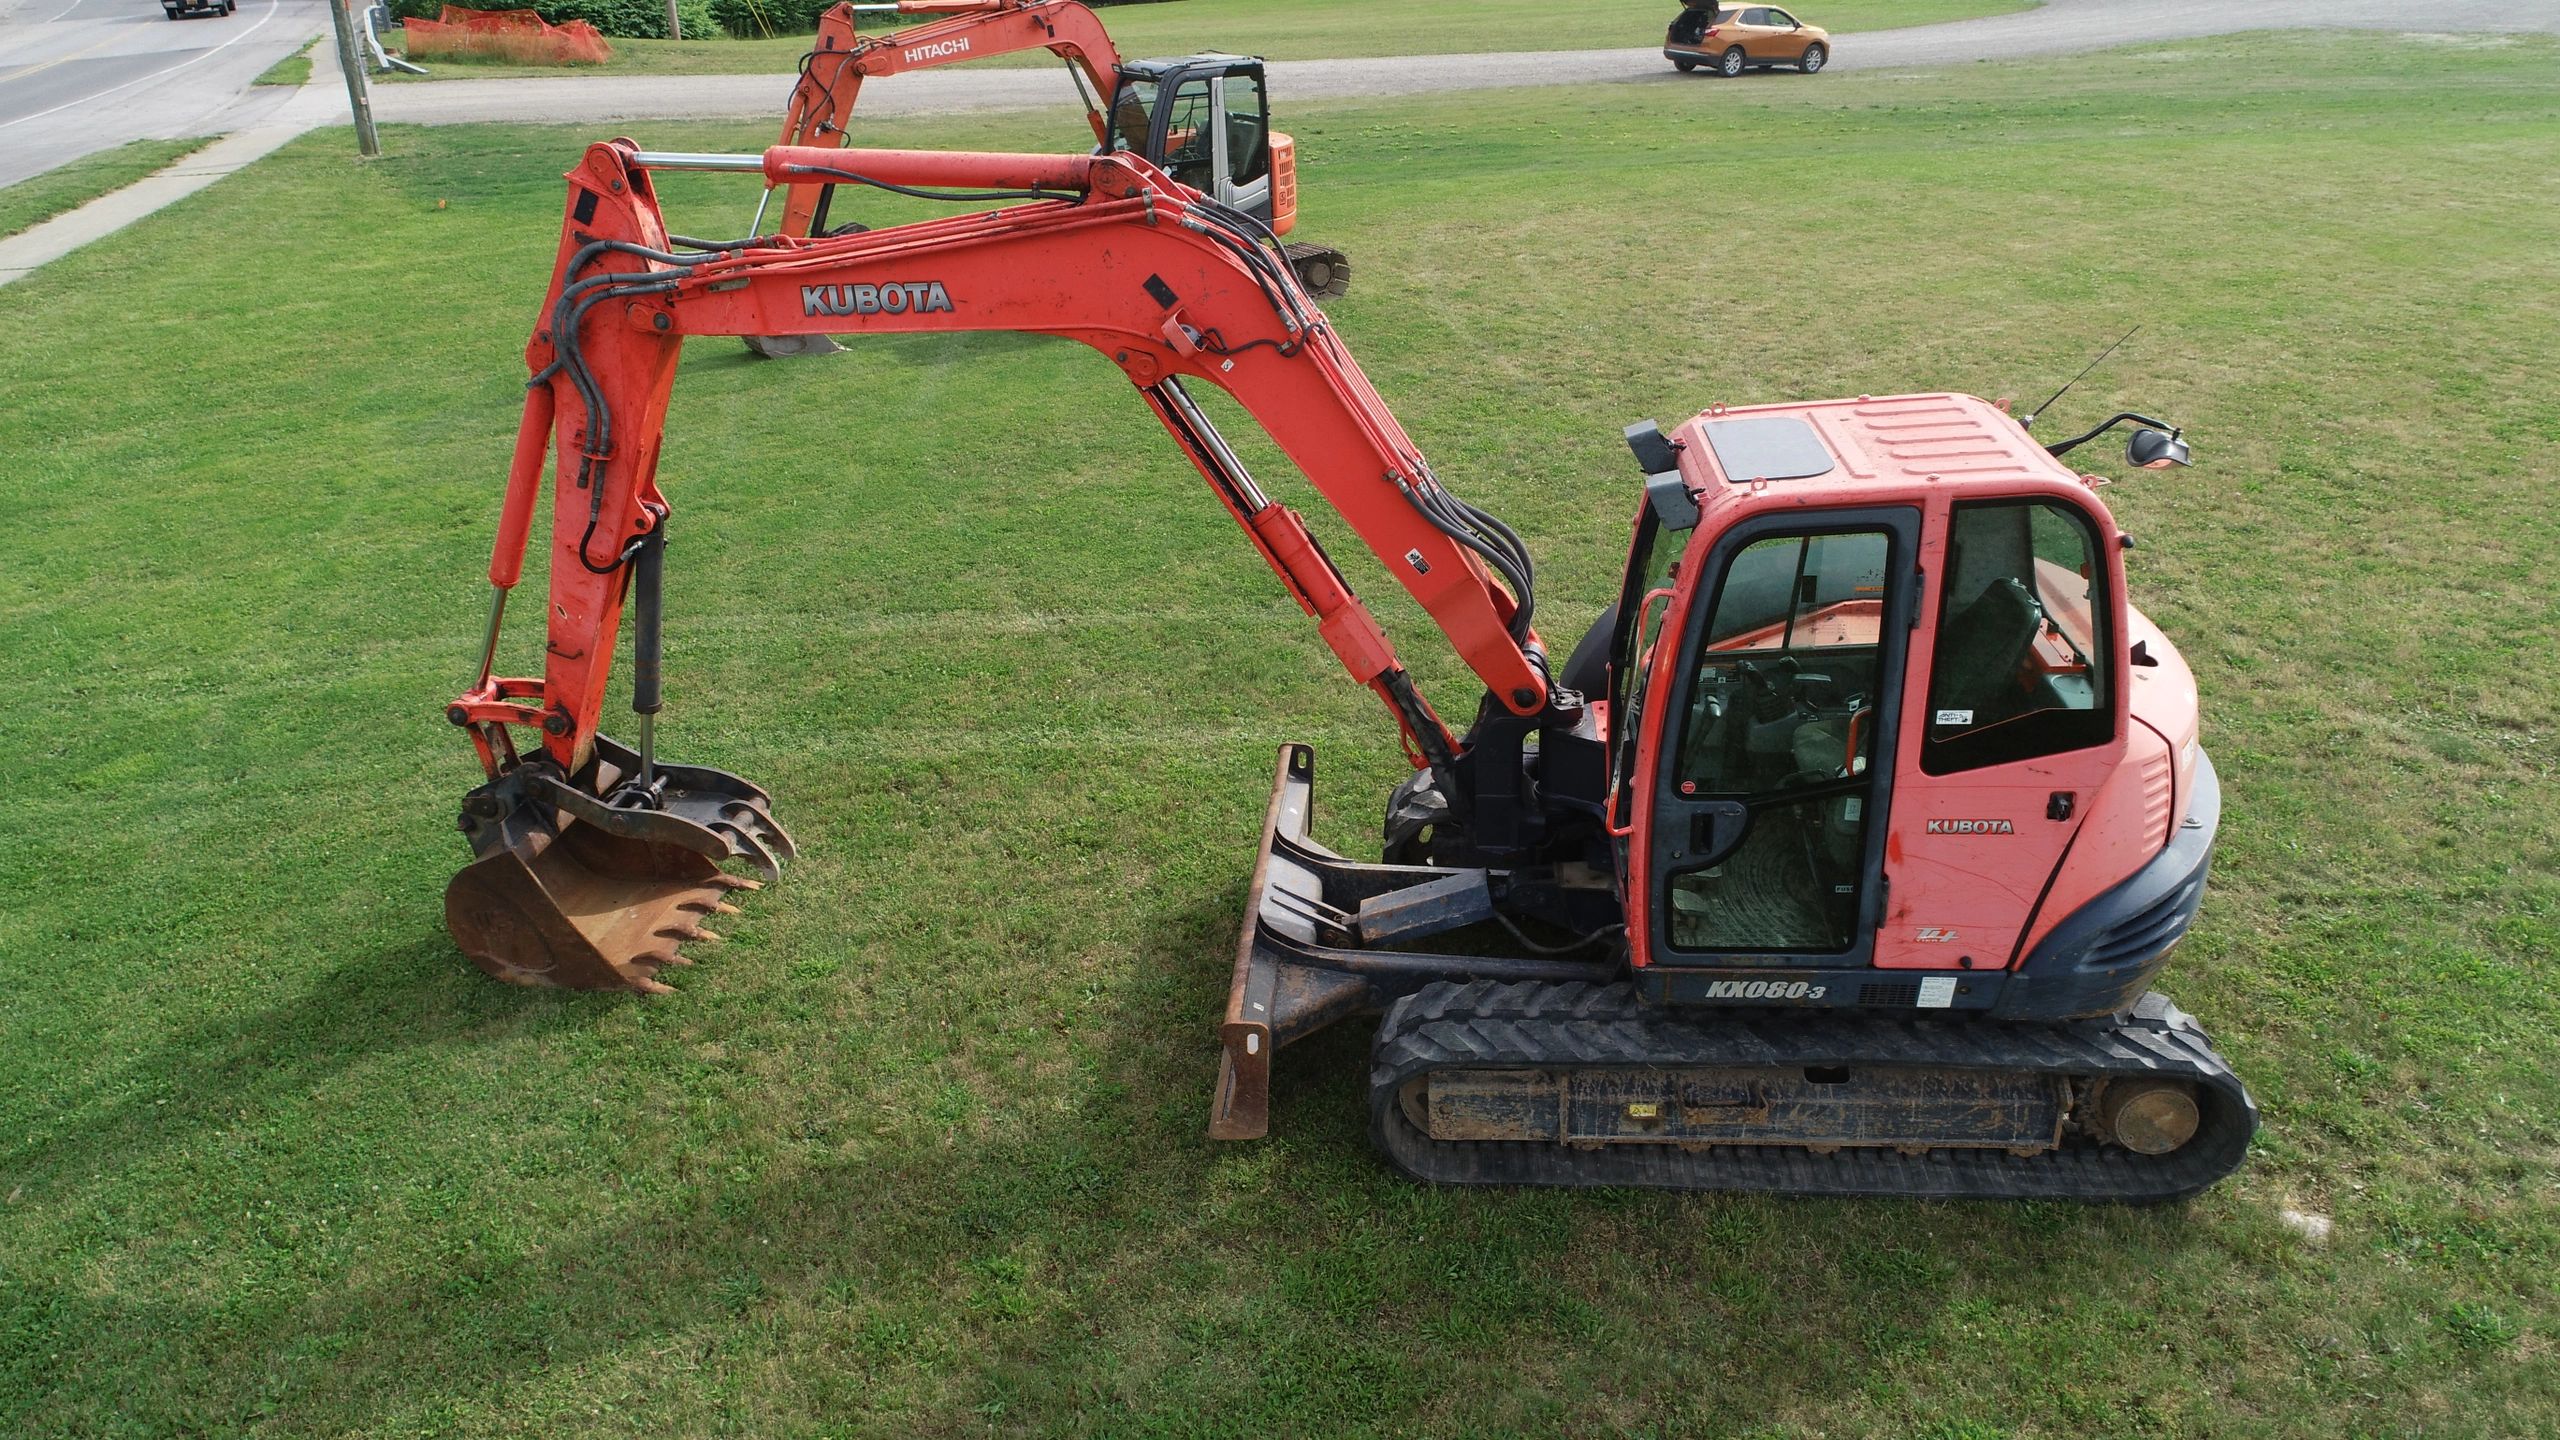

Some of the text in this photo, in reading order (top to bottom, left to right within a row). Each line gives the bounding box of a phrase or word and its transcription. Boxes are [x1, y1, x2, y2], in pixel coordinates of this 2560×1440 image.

[904, 37, 970, 63] HITACHI
[801, 281, 954, 316] KUBOTA
[1927, 819, 2014, 834] KUBOTA
[1705, 981, 1826, 998] KX080-3
